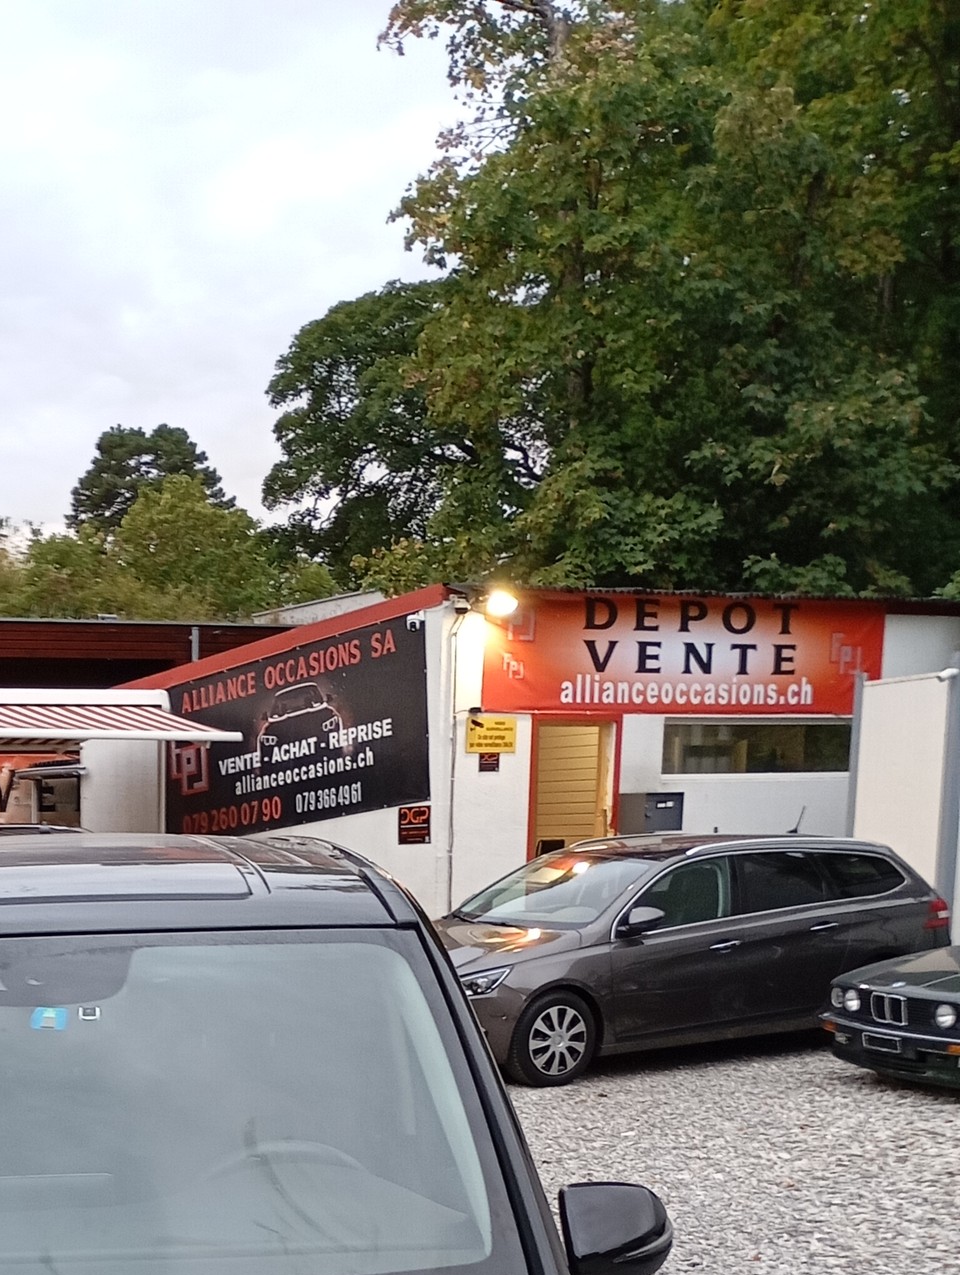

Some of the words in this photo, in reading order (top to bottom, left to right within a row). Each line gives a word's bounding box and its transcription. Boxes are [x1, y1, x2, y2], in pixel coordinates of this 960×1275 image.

[582, 597, 799, 635] DEPOT
[181, 671, 257, 714] ALLIANCE
[264, 638, 361, 690] OCCASIONS
[370, 629, 397, 659] SA
[582, 639, 797, 676] VENTE
[560, 673, 814, 706] allianceoccasions.ch
[218, 750, 262, 776] VENTE
[271, 737, 318, 764] ACHAT
[328, 718, 393, 749] REPRISE
[234, 746, 375, 796] allianceoccasions.ch
